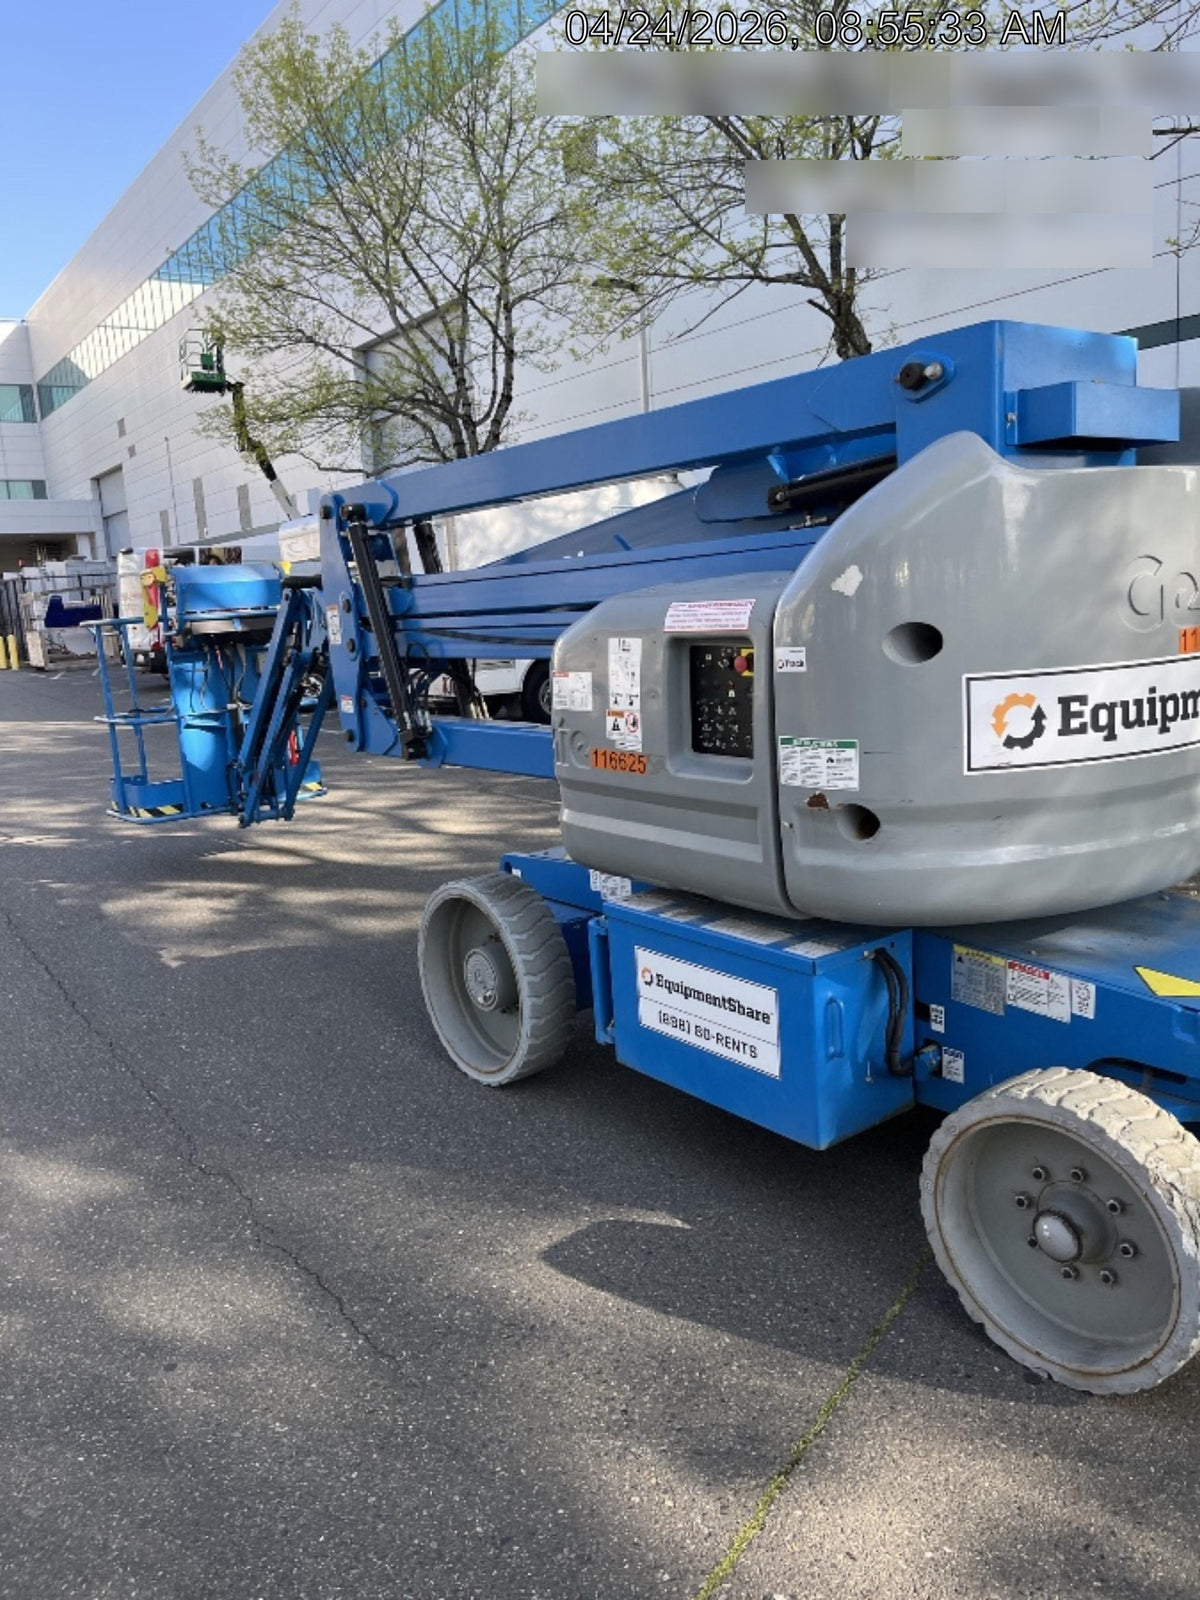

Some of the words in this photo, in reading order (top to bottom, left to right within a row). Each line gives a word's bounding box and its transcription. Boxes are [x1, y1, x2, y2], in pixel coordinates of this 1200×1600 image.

[591, 748, 647, 775] 116625
[655, 973, 771, 1025] EquipmentShare
[658, 1010, 691, 1034] (888)
[694, 1025, 758, 1059] 80-RENTS
